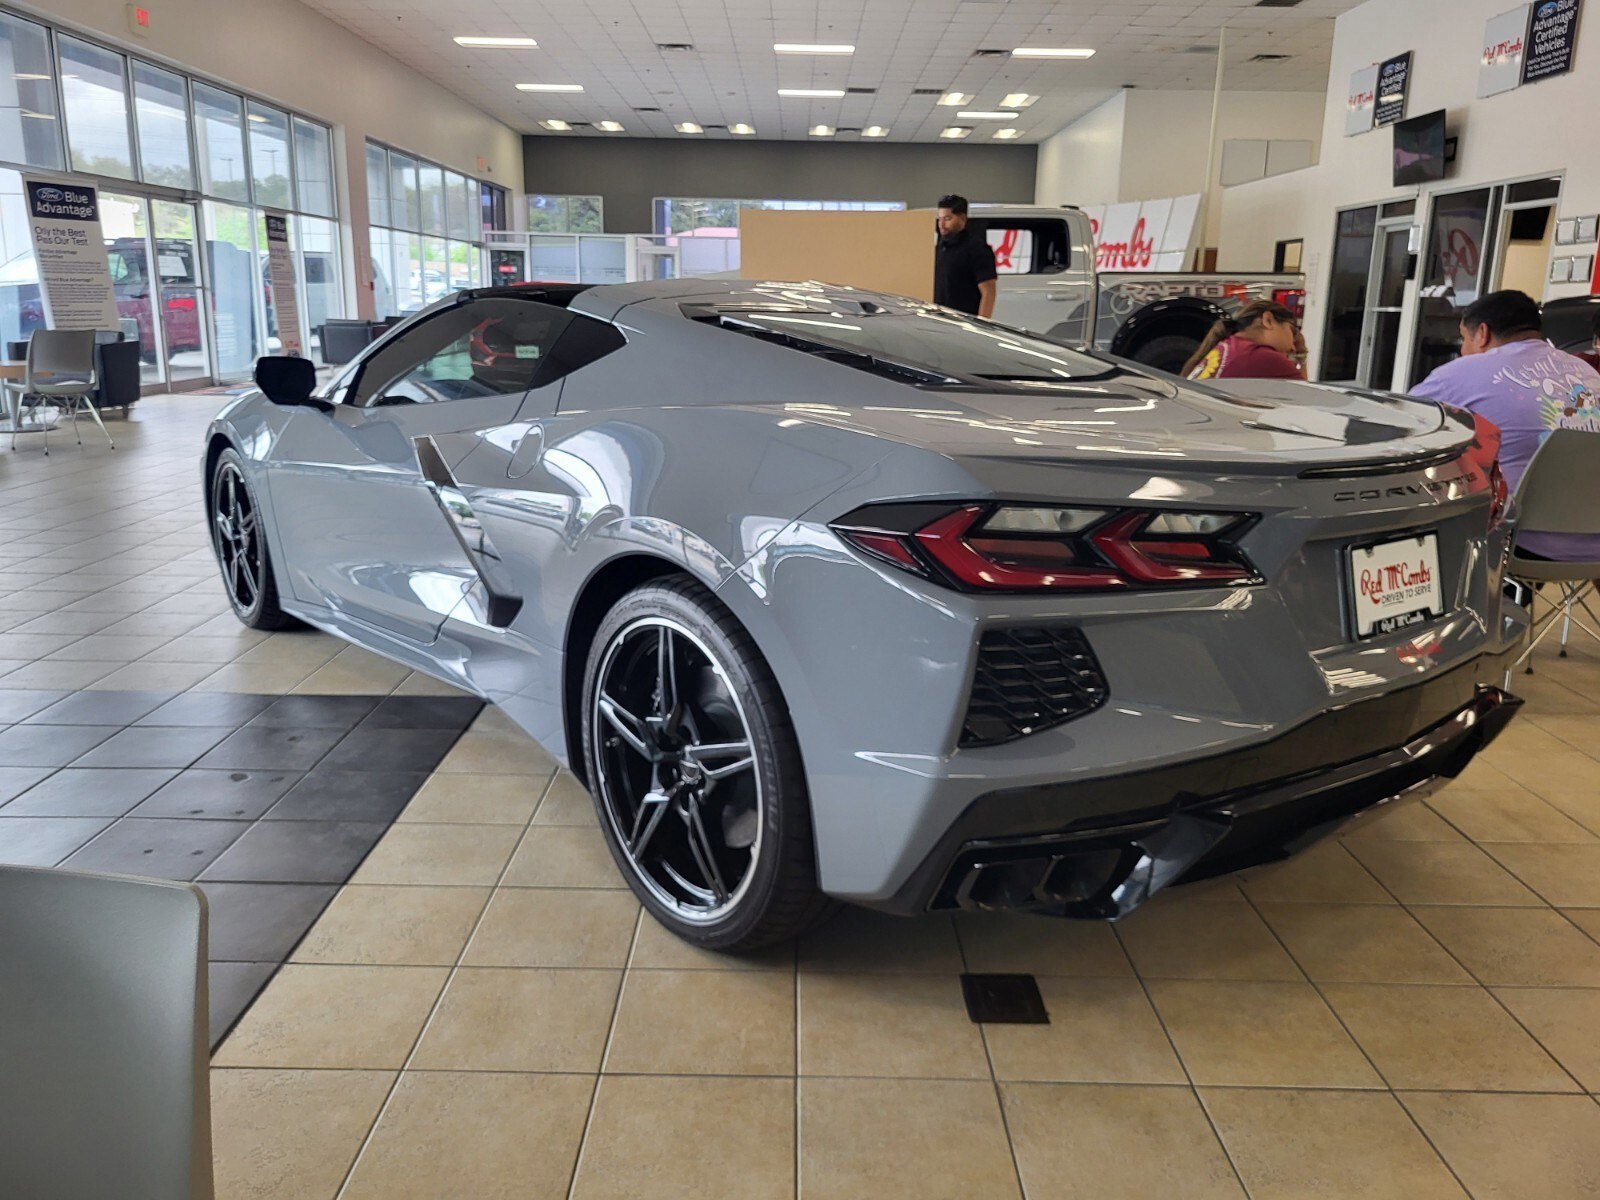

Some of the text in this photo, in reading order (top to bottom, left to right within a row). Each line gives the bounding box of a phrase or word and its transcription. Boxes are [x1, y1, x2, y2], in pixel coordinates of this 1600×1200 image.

[1535, 23, 1568, 43] Certified
[1534, 37, 1566, 55] Vehicles
[65, 191, 88, 204] Blue
[53, 228, 66, 236] the
[68, 228, 86, 238] Best
[54, 236, 70, 245] Our
[71, 237, 88, 246] Test
[1120, 284, 1248, 303] RAPTOR
[1361, 560, 1430, 604] Red McCombs
[1381, 583, 1432, 605] DRIVEN TO SERVE
